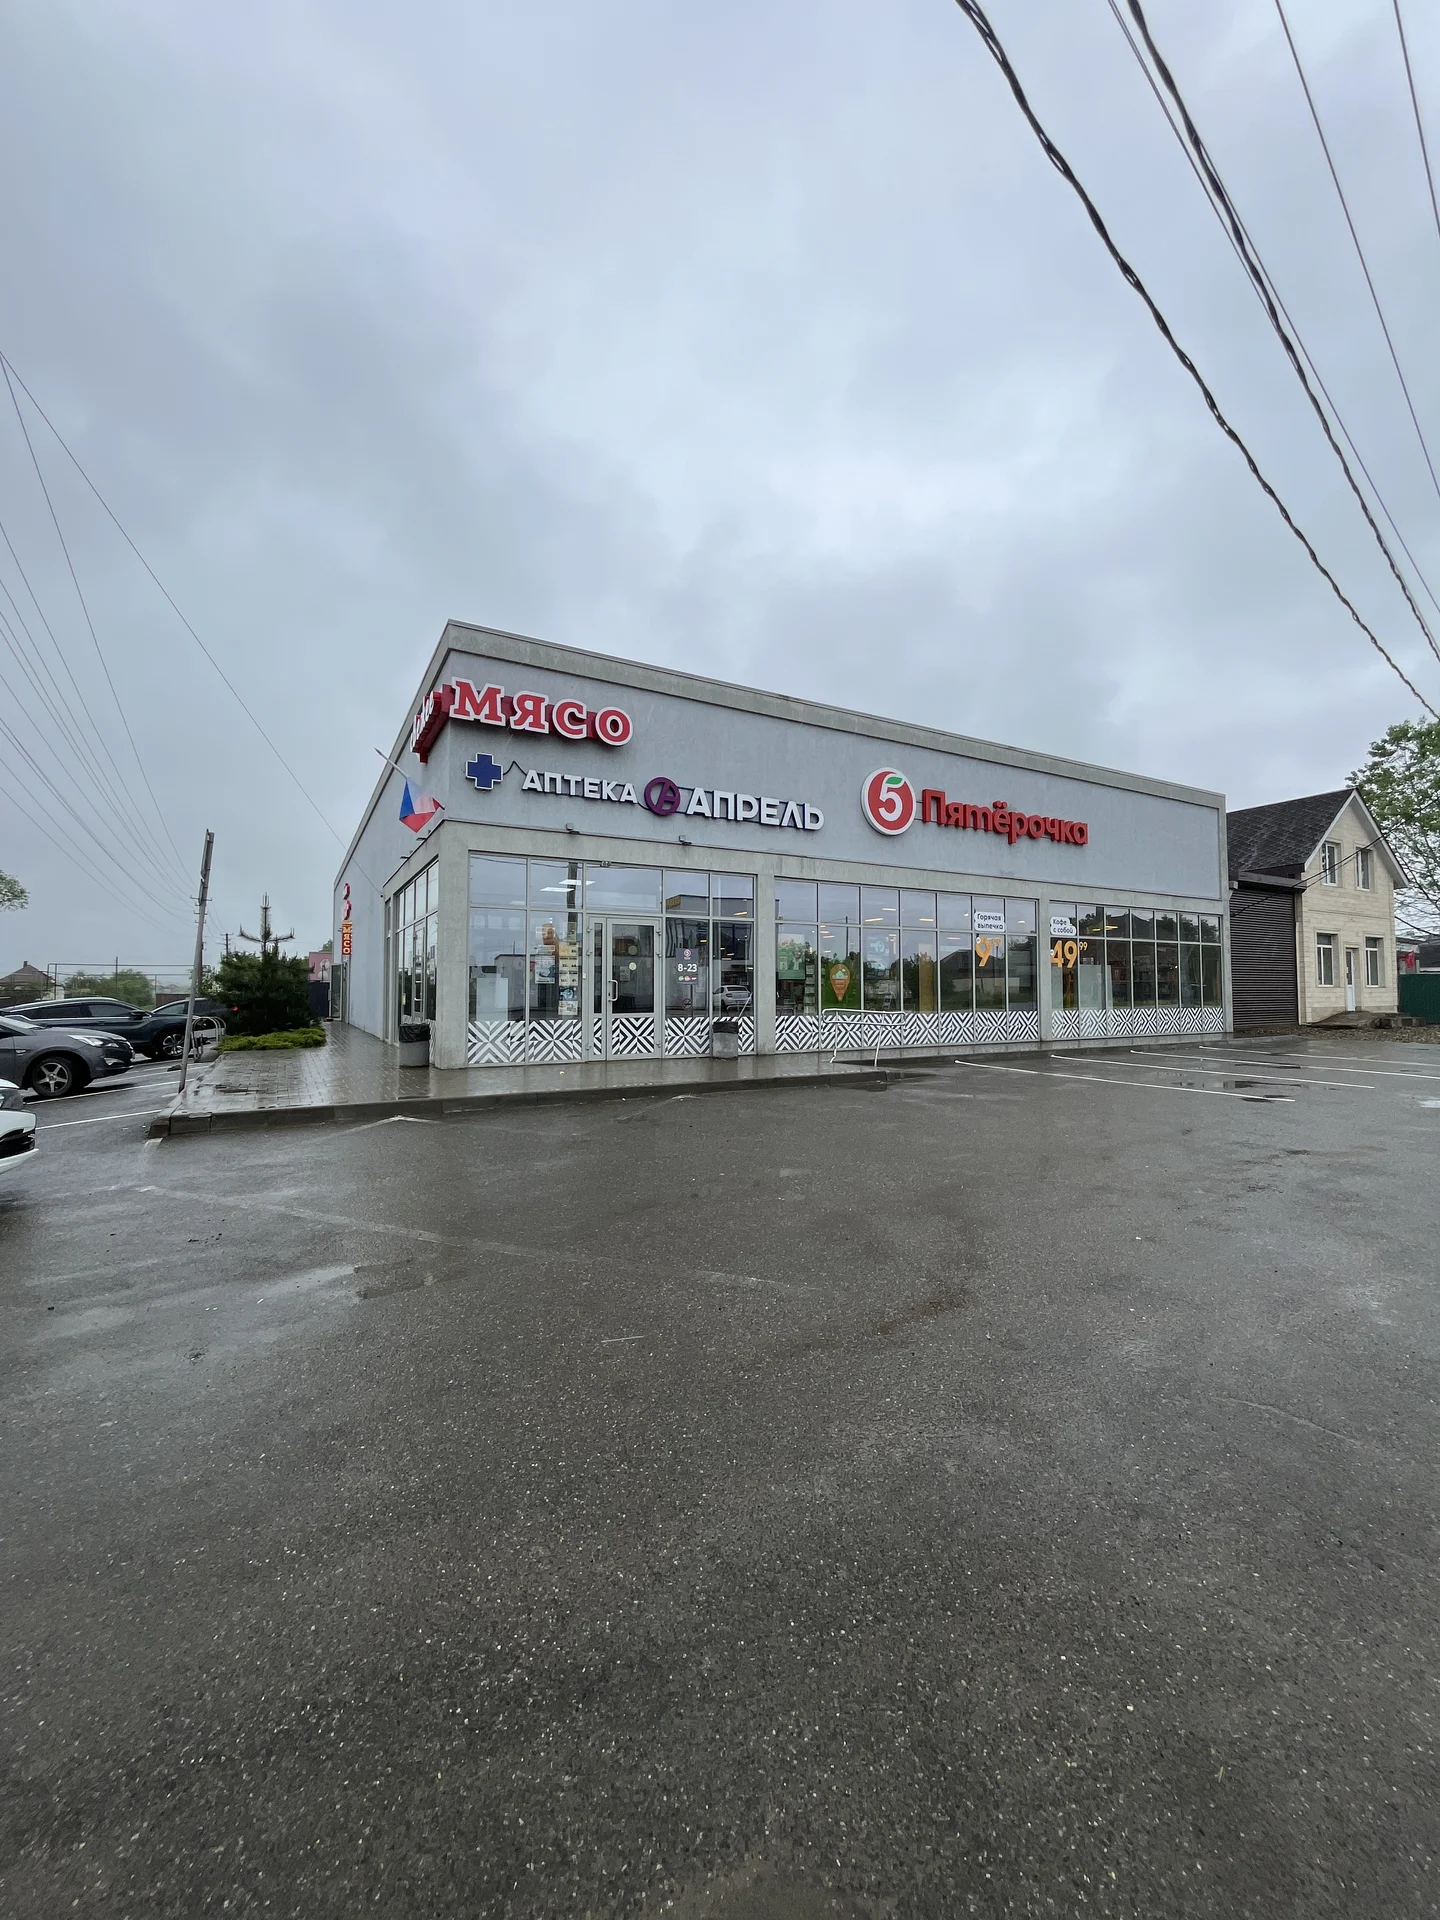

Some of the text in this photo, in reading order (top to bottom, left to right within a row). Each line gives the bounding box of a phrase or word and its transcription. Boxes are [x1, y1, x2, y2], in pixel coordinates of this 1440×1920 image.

[450, 677, 633, 746] МЯСО
[521, 769, 638, 804] АПТЕКА
[686, 786, 824, 831] АПРЕЛЬ
[922, 788, 1089, 845] Пятёрочка
[977, 913, 1001, 922] Горячая
[1052, 918, 1067, 926] Кофе
[977, 922, 1004, 930] выпечка
[1058, 926, 1074, 934] собой
[677, 963, 698, 972] 8-23
